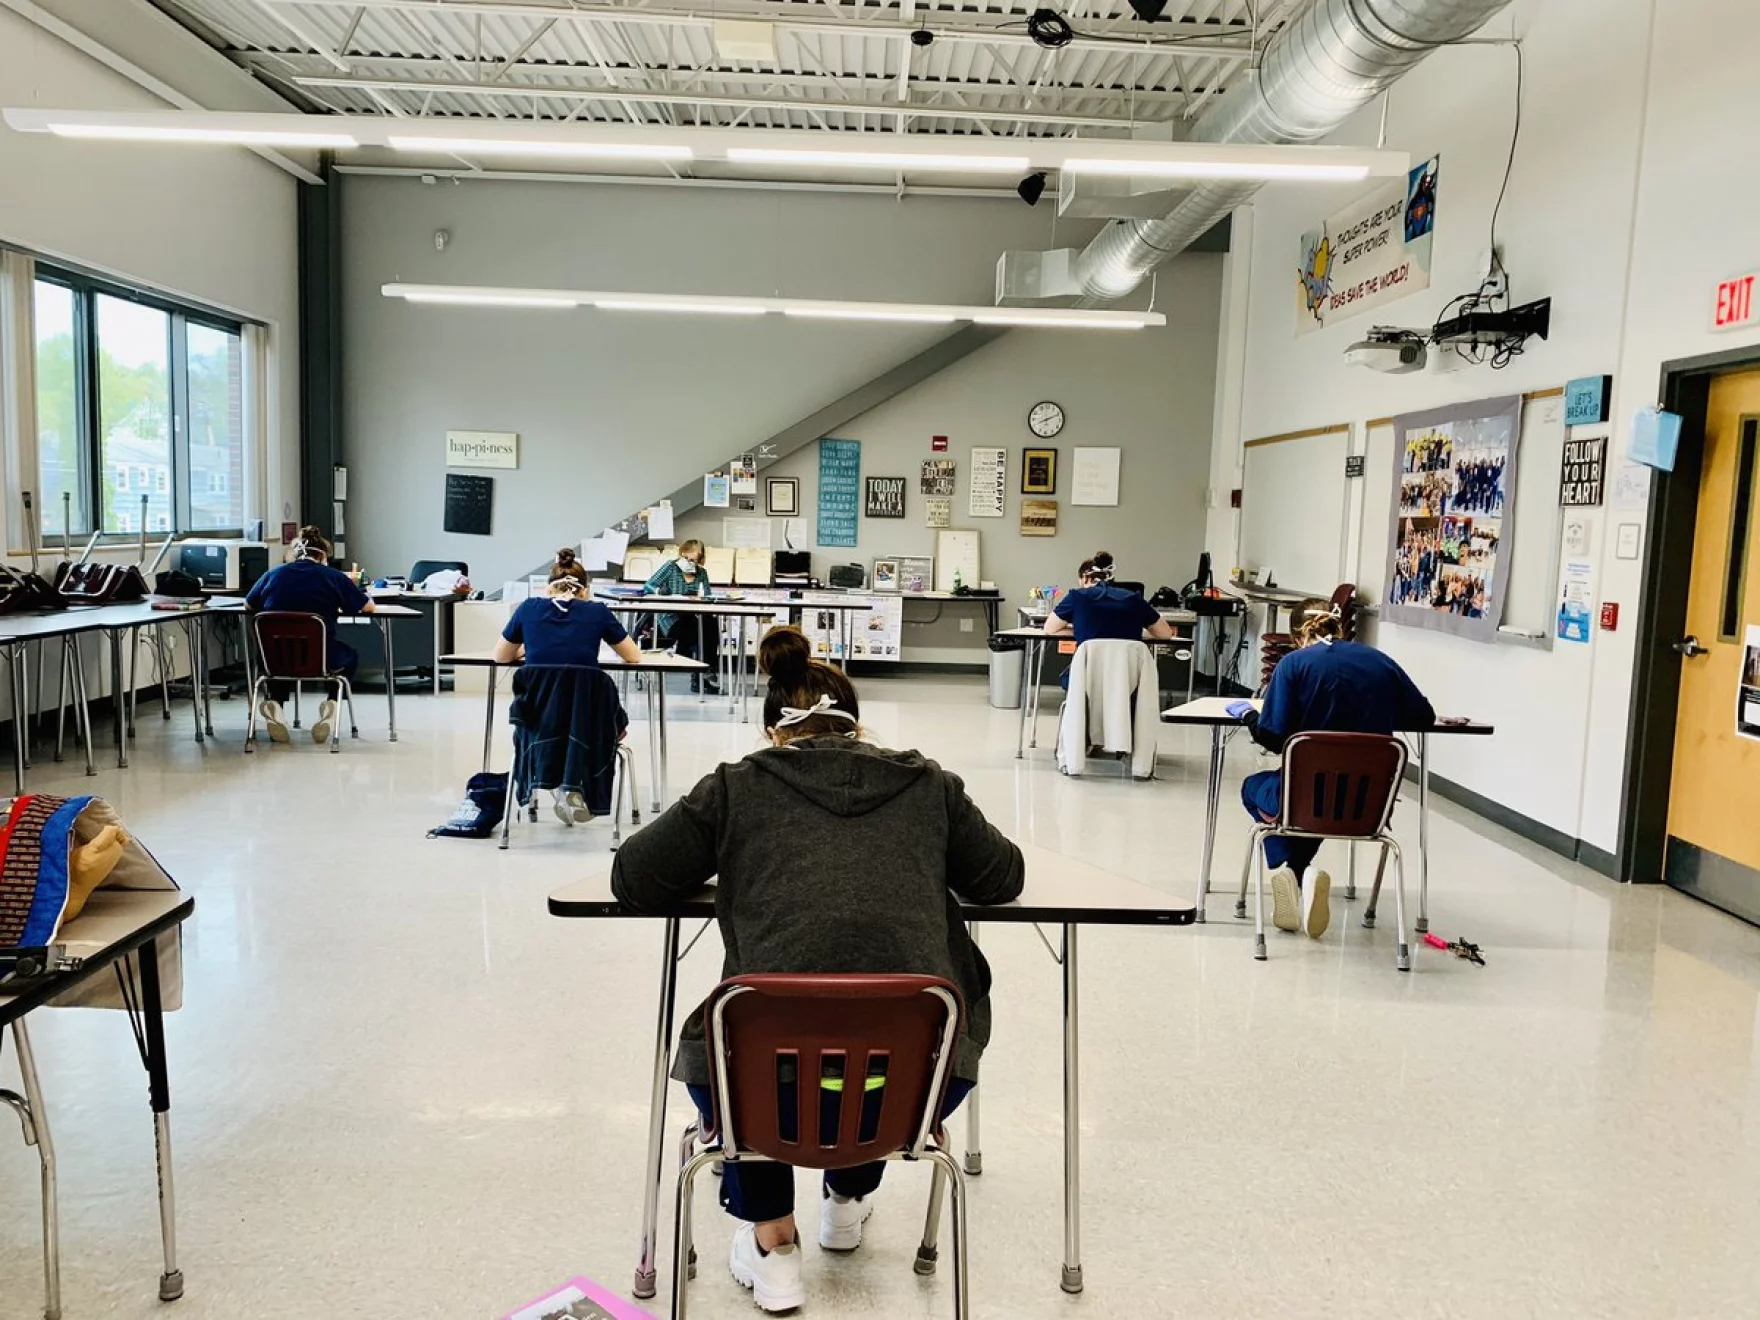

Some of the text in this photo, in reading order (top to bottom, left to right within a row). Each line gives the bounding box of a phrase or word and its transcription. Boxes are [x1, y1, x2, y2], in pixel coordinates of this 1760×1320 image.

[1370, 210, 1384, 230] ARE
[1383, 199, 1403, 222] YOUR
[1347, 282, 1365, 303] SAVE
[1365, 276, 1378, 296] THE
[1379, 262, 1410, 290] WORLD!
[1716, 276, 1757, 326] EXIT
[1567, 405, 1589, 419] BREAK
[1589, 402, 1599, 416] UP
[1564, 441, 1600, 464] FOLLOW
[995, 451, 1005, 513] BE HAPPY
[1563, 464, 1599, 482] YOUR
[868, 479, 904, 493] TODAY
[878, 492, 903, 502] WILL
[1561, 482, 1599, 505] HEART
[867, 501, 893, 510] MAKE
